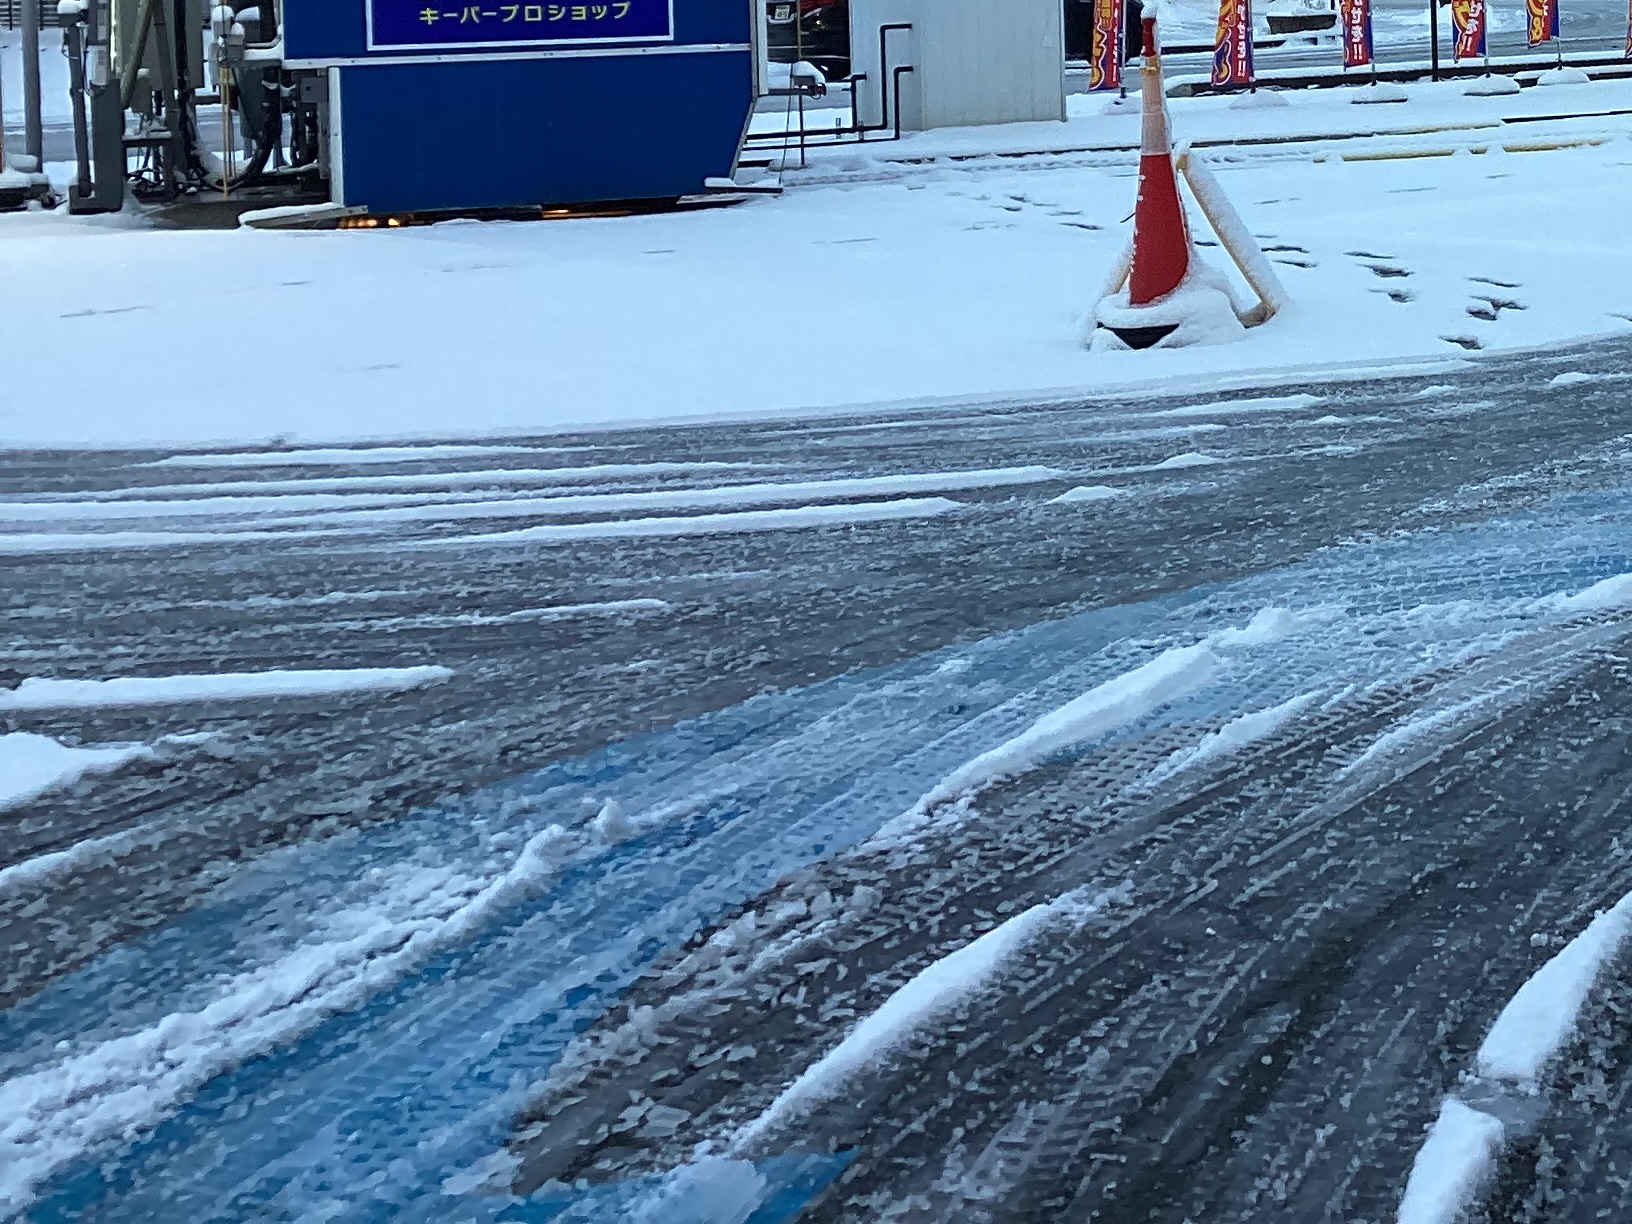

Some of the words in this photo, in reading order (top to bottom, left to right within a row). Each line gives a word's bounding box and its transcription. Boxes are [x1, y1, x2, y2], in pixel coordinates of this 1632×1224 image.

[419, 1, 631, 25] キーパープロショップ
